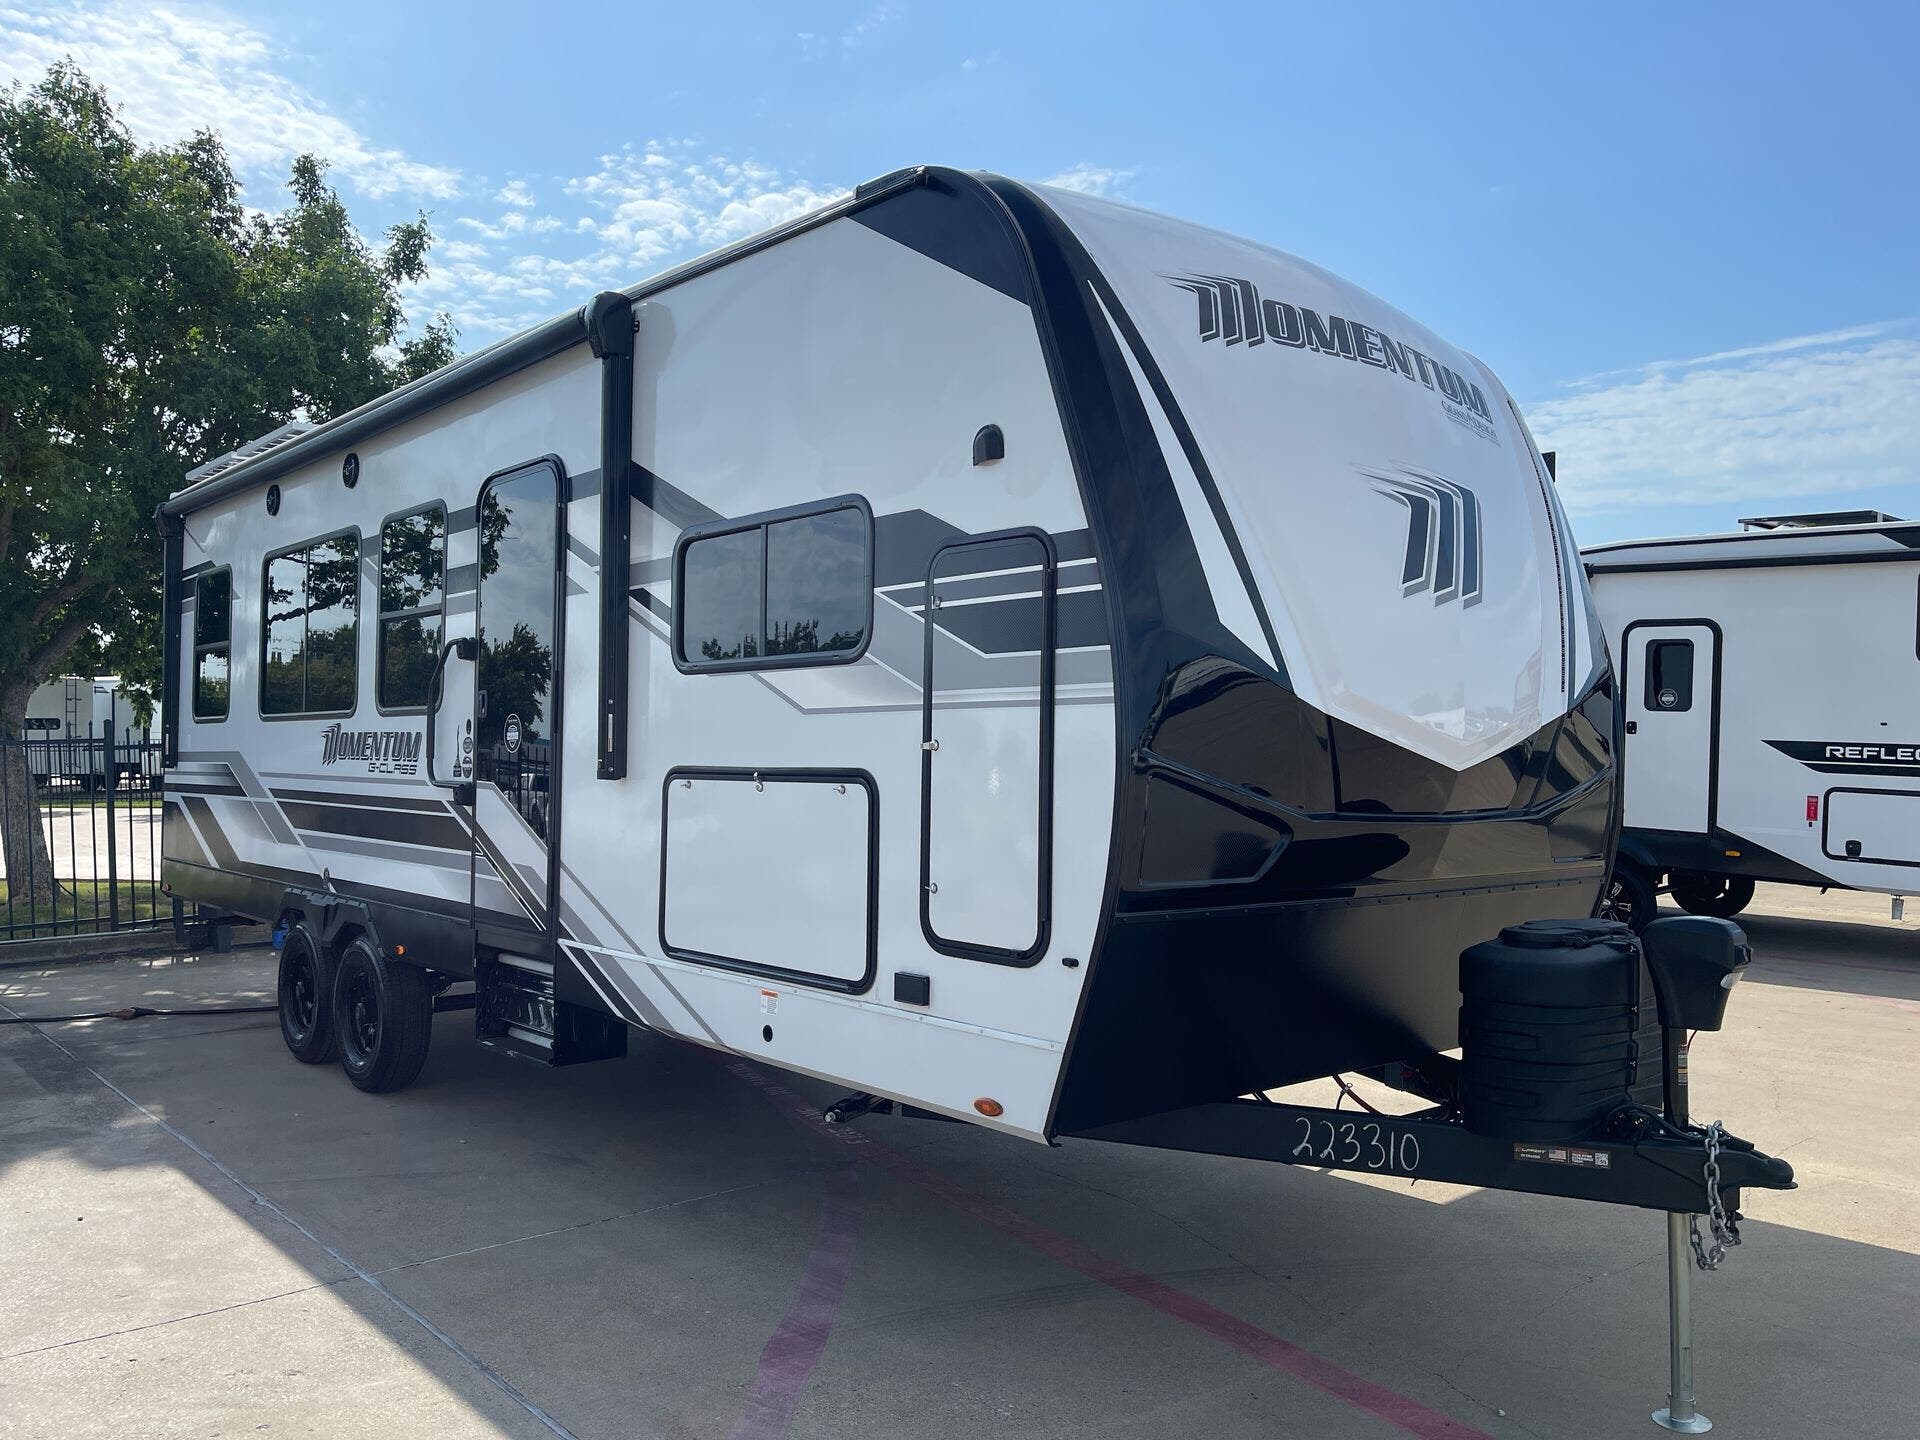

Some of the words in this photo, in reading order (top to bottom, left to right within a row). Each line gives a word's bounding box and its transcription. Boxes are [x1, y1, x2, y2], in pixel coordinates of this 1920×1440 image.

[1156, 271, 1494, 425] MOMENTUM
[320, 722, 423, 766] MOMENTUM
[1825, 745, 1920, 760] REFLE
[367, 762, 418, 776] G-CLASS
[1292, 1117, 1420, 1172] 223310
